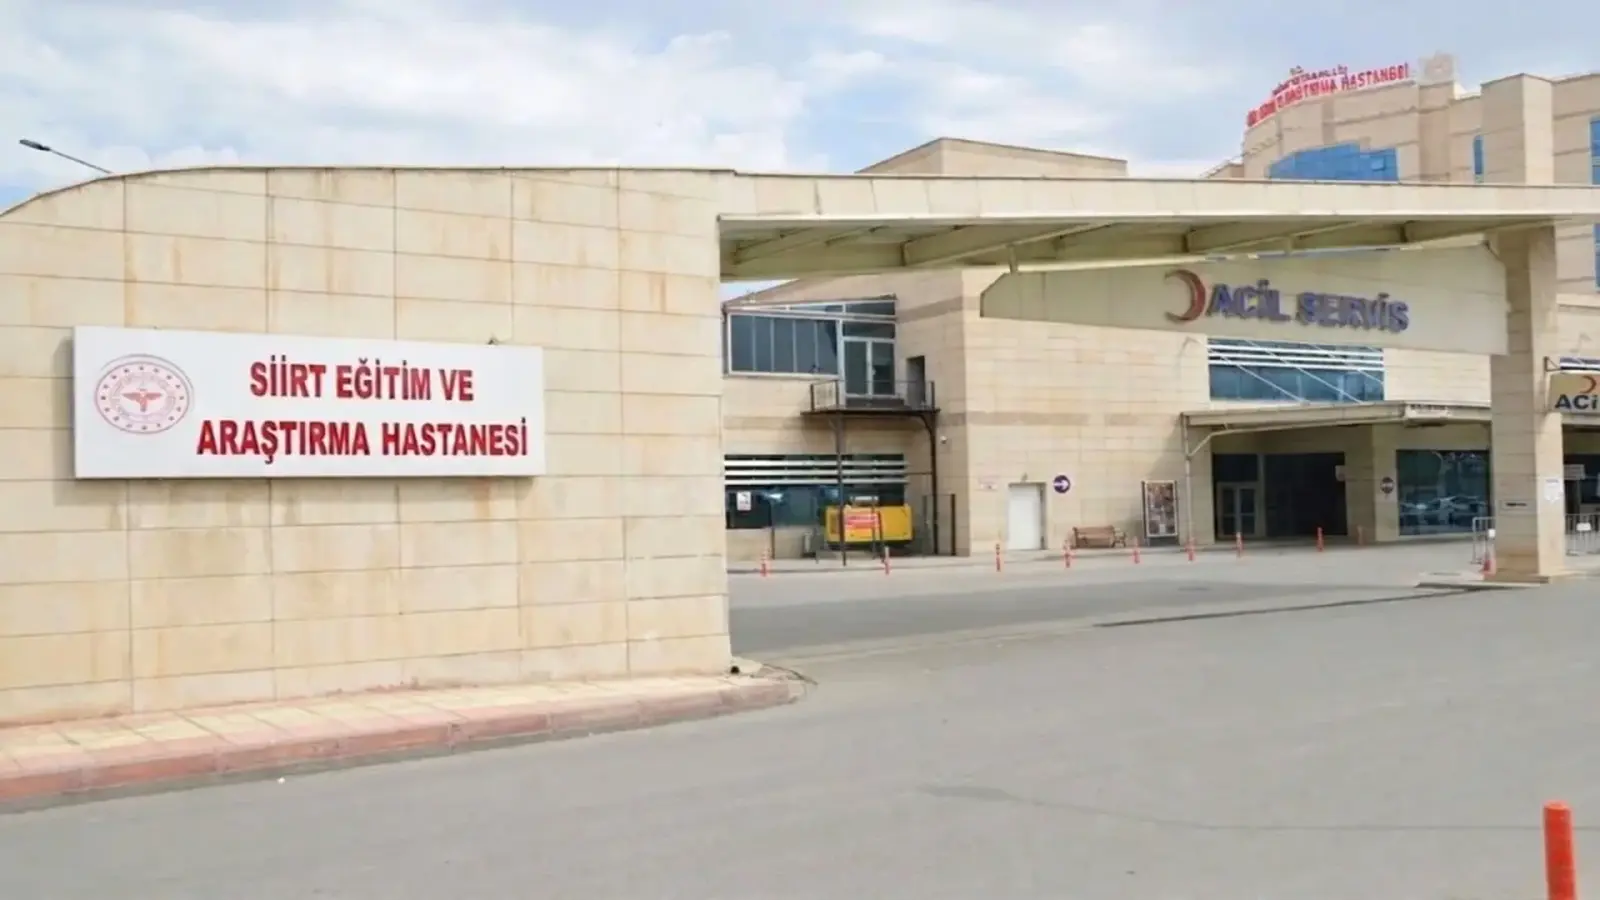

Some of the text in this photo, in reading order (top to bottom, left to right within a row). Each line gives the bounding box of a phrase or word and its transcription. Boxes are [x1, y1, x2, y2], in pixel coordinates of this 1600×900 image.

[1206, 279, 1409, 333] ACİL SERVİS
[250, 354, 474, 401] SİİRT EĞİTİM VE
[196, 417, 528, 465] ARAŞTIRMA HASTANESİ
